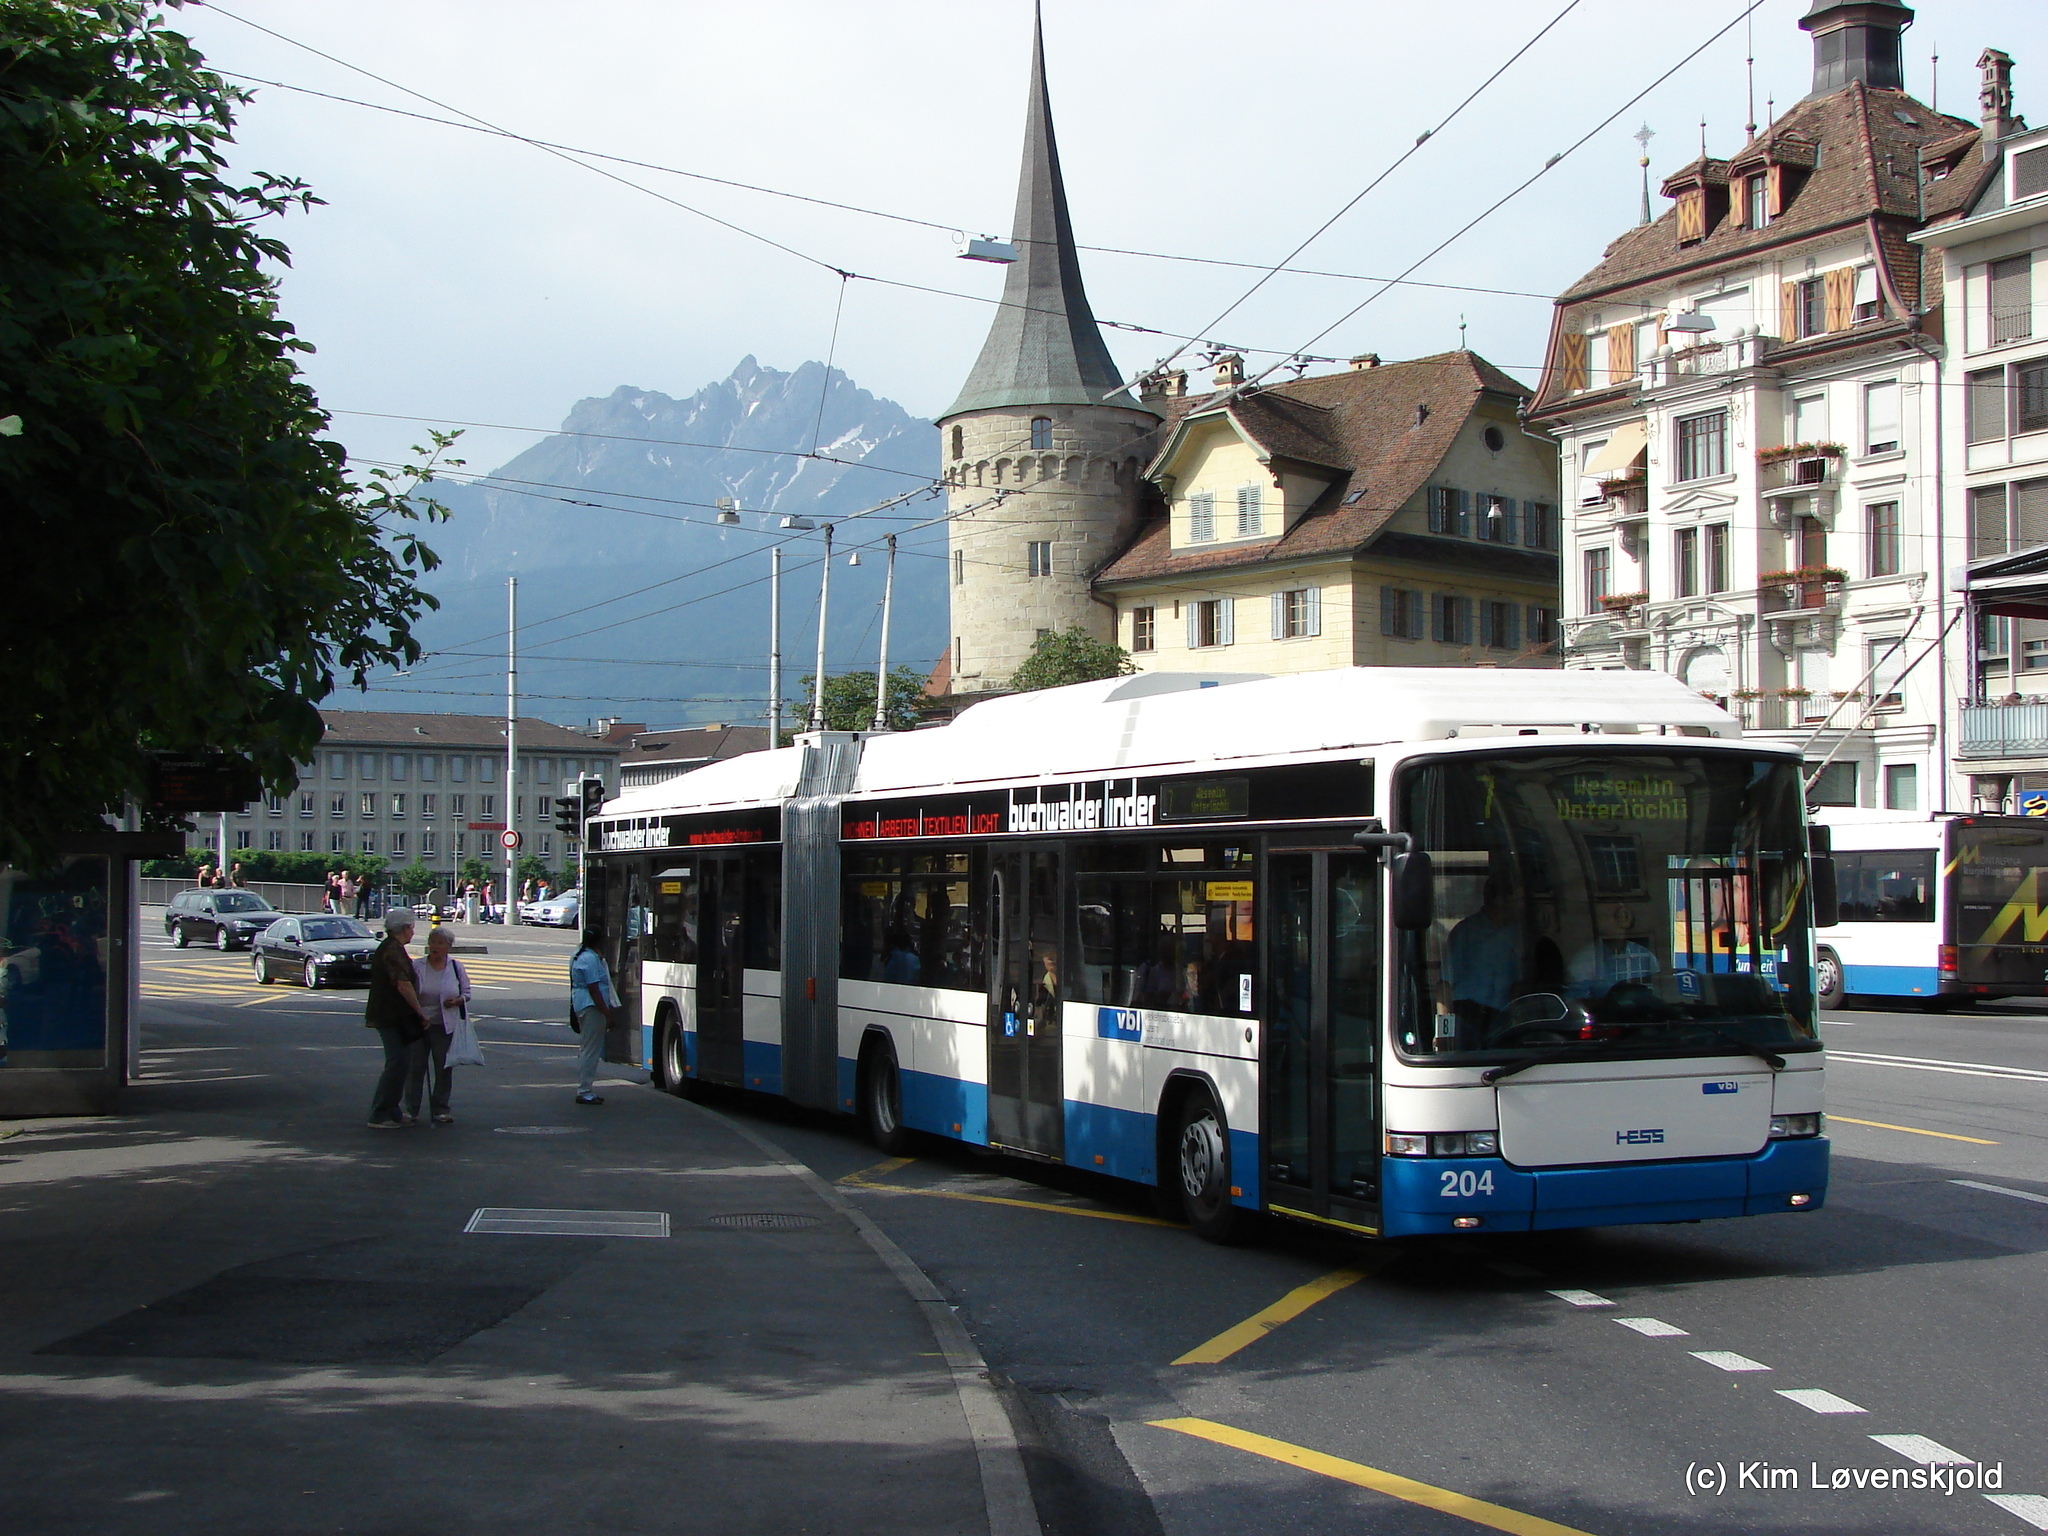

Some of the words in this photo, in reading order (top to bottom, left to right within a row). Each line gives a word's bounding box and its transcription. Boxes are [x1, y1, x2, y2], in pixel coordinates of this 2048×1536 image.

[1477, 775, 1494, 818] 7
[1573, 775, 1674, 796] Wesemlin
[1008, 783, 1102, 832] buchwalder
[1103, 778, 1157, 828] linder
[1557, 798, 1688, 820] Unterlöchli
[843, 820, 875, 838] WOHNEN
[880, 818, 918, 837] ARBEITEN
[924, 816, 967, 835] TEXTILIEN
[972, 813, 1000, 833] LICHT
[1116, 1009, 1141, 1032] vbl
[1718, 1081, 1737, 1090] vbl
[1616, 1129, 1664, 1145] HESS
[1440, 1170, 1494, 1197] 204
